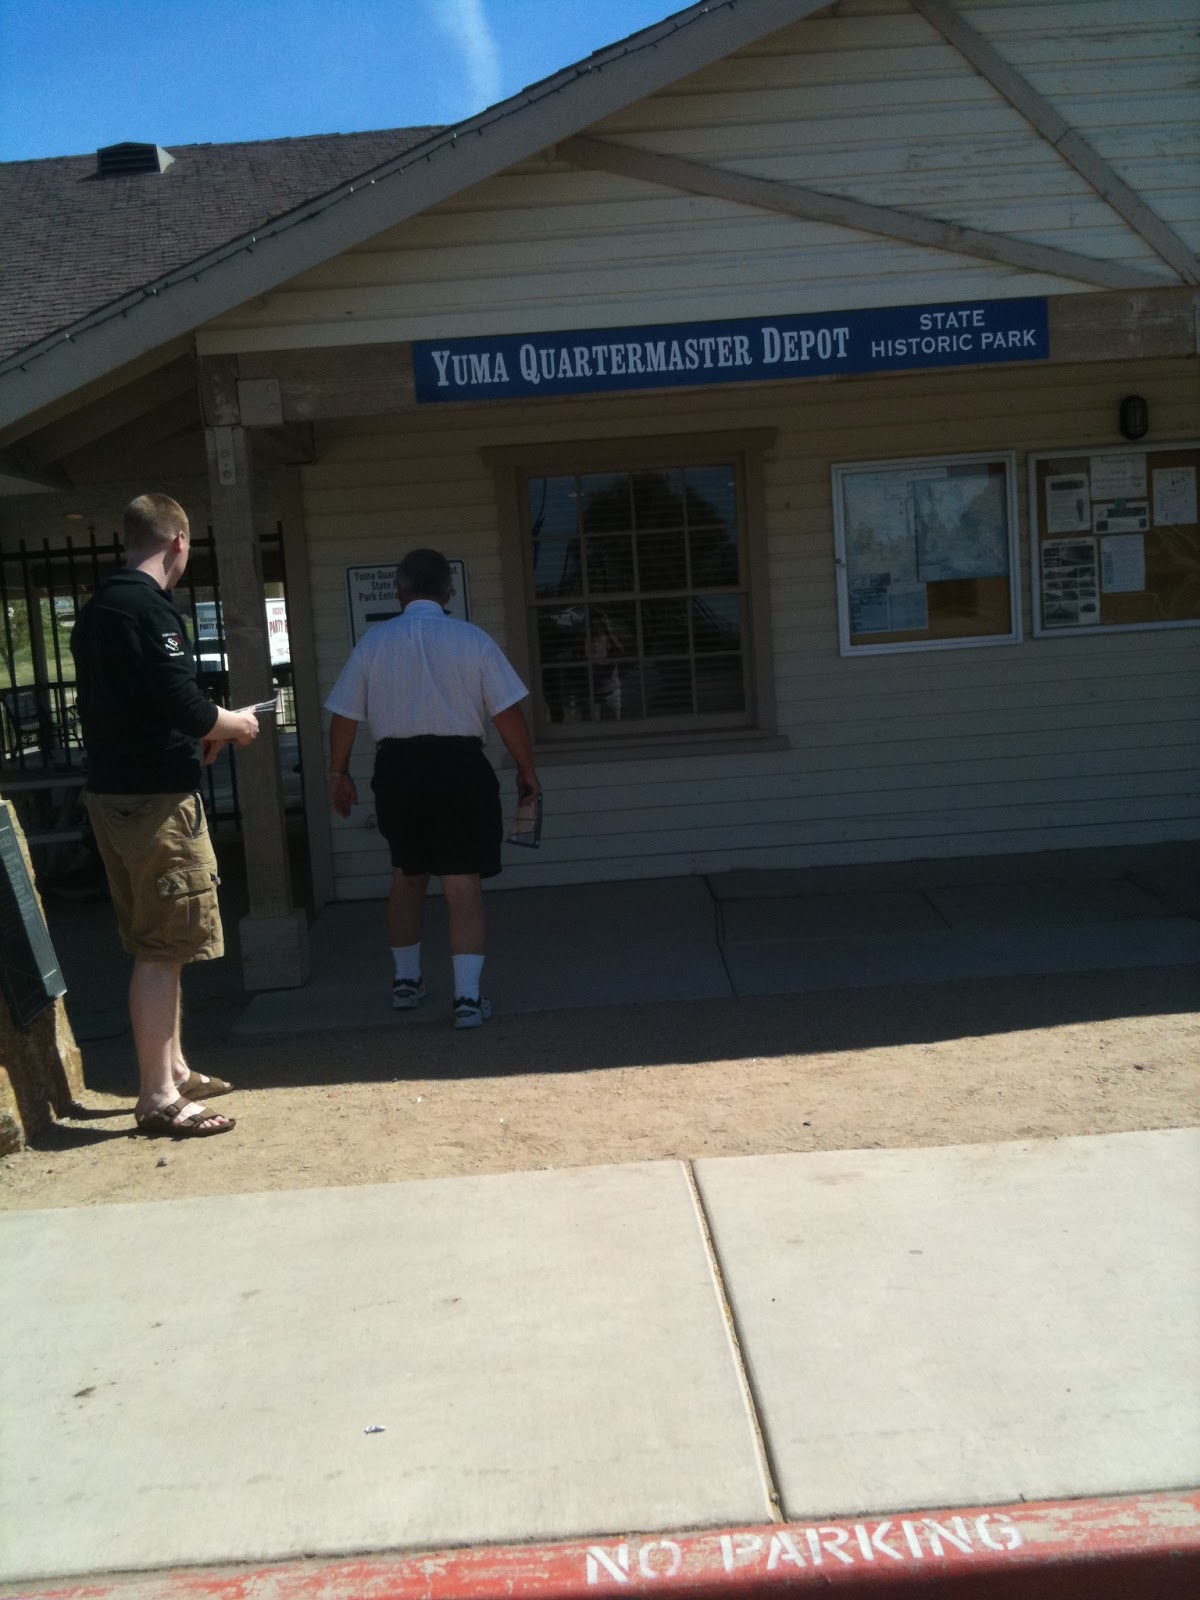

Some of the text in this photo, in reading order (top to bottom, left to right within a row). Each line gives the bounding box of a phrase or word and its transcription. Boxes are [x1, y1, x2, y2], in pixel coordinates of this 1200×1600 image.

[919, 309, 986, 332] STATE
[871, 329, 1037, 358] HISTORIC PARK
[430, 326, 849, 387] YUMA QUARTERMASTER DEPOT
[354, 571, 376, 581] Yuma
[371, 581, 391, 590] State
[359, 592, 377, 601] Park
[585, 1513, 1026, 1585] NO PARKING
